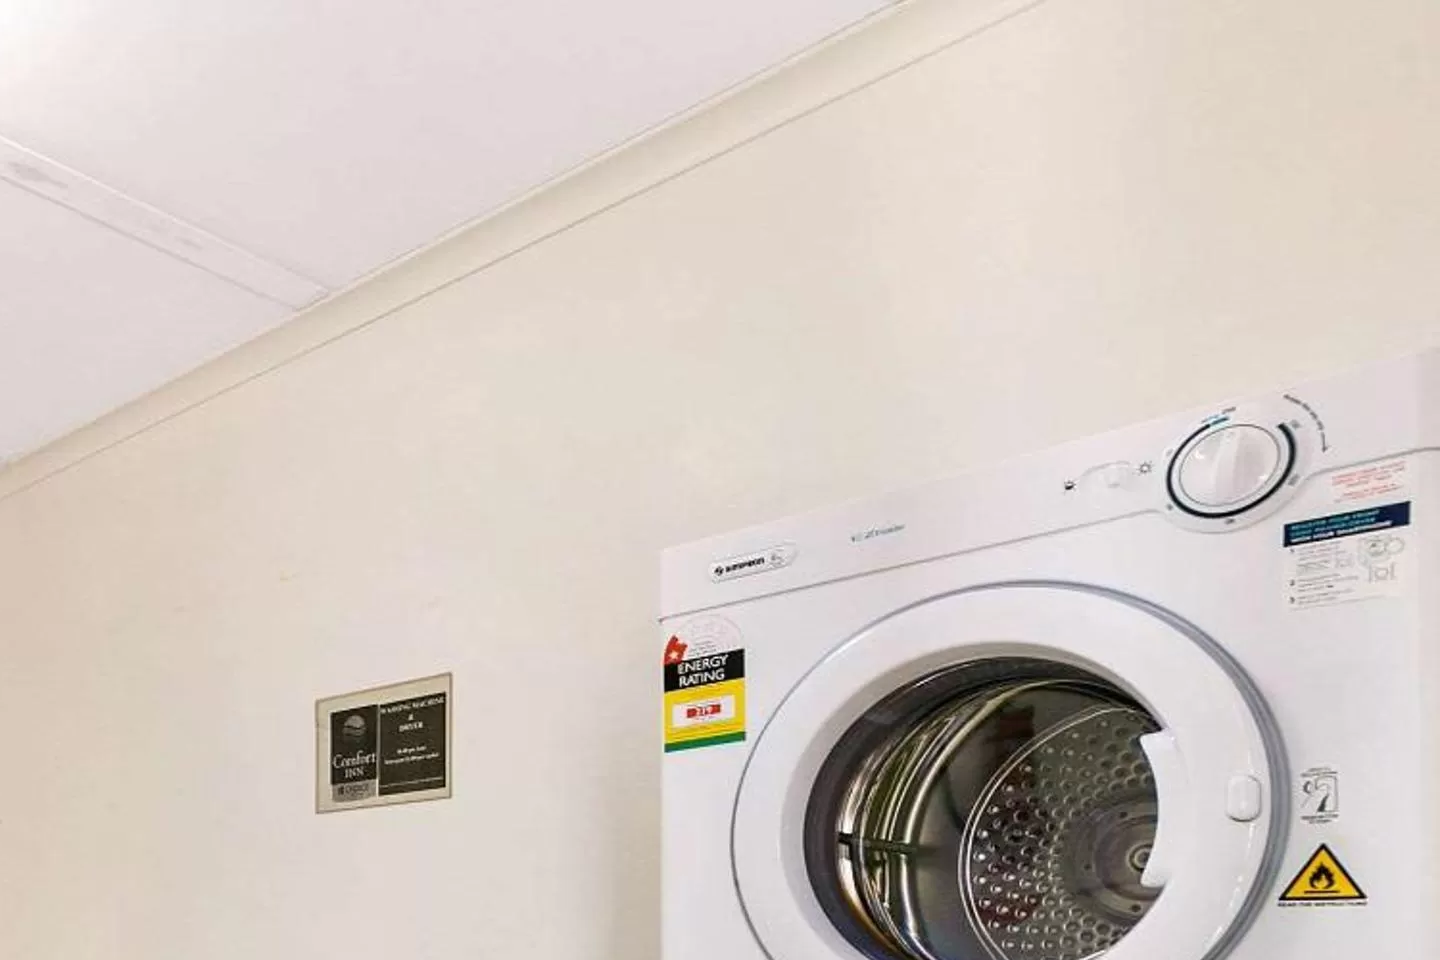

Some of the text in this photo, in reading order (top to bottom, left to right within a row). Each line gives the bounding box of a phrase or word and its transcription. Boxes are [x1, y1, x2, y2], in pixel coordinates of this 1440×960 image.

[677, 655, 728, 674] ENERGY
[679, 668, 725, 687] RATING
[332, 750, 376, 769] Comfort
[344, 767, 364, 779] INN
